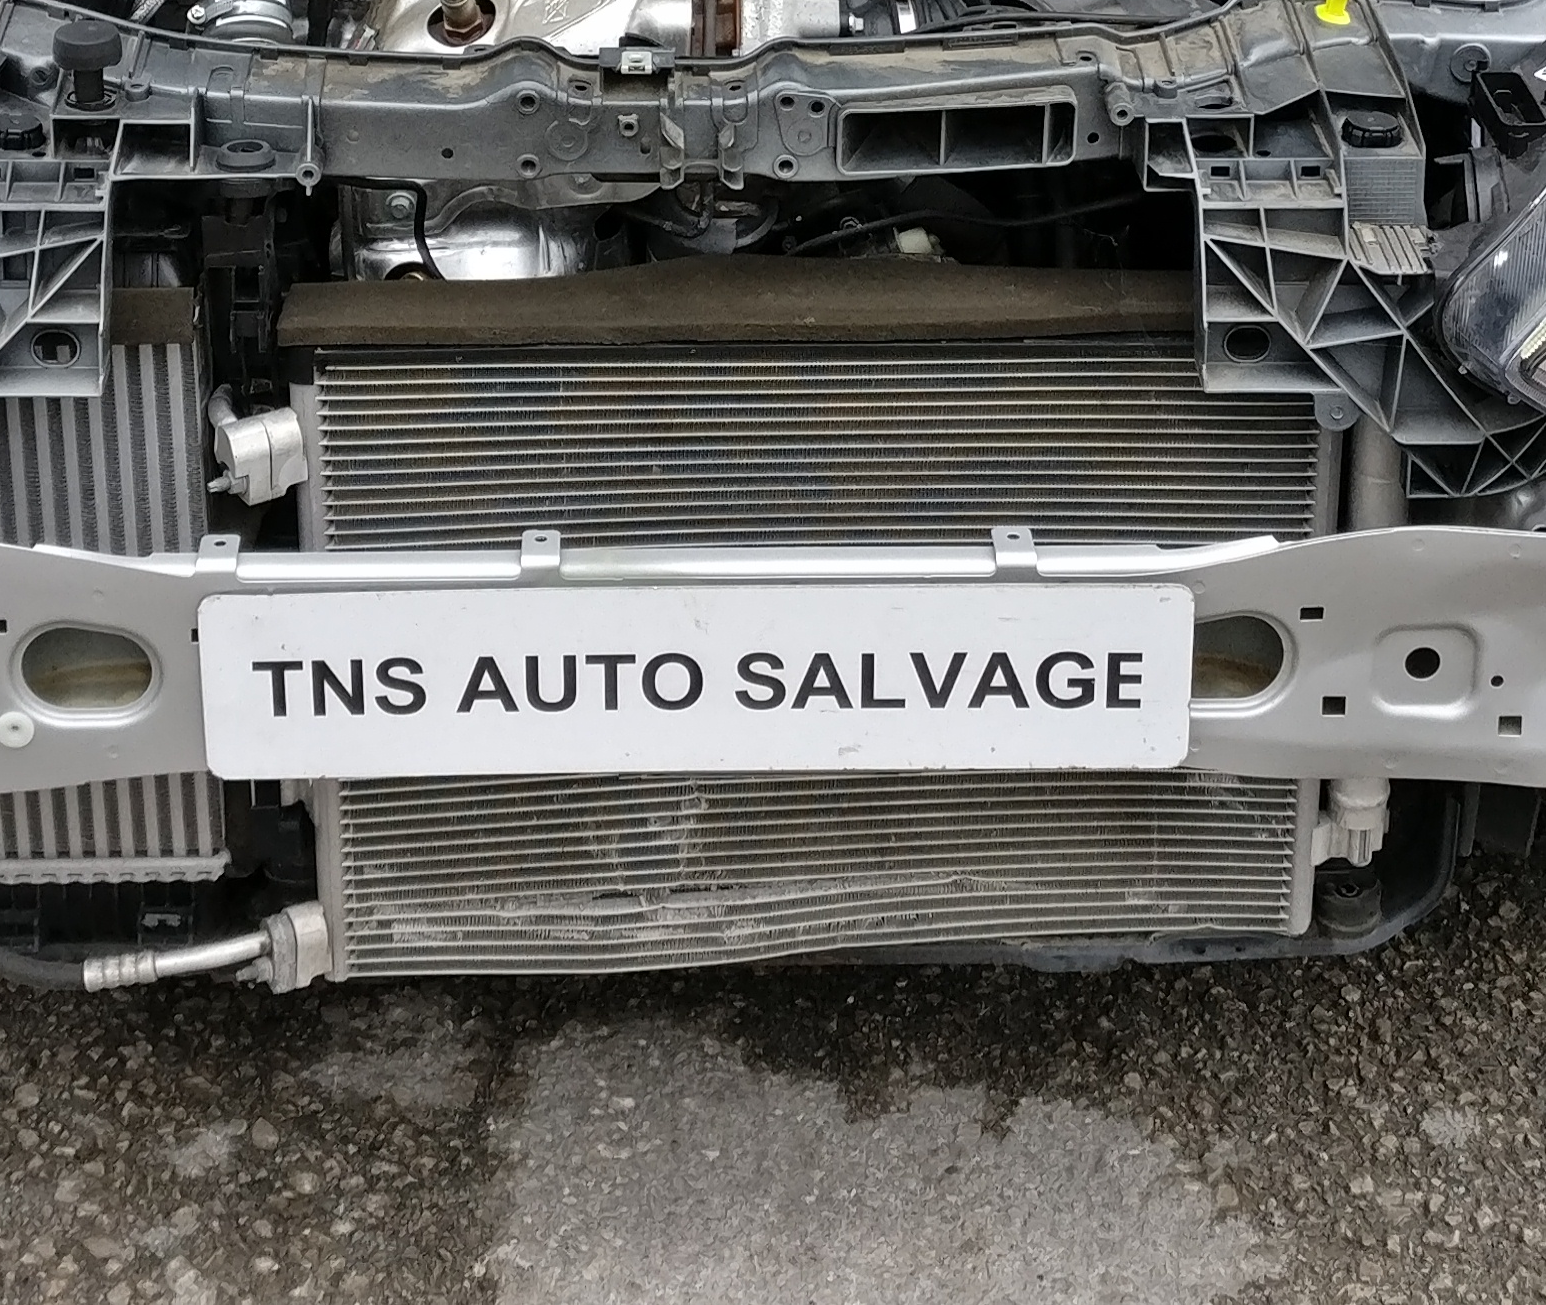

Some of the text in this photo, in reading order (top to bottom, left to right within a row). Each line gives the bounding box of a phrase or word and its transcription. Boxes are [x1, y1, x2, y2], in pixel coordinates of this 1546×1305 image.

[251, 650, 1144, 718] TNS AUTO SALVAGE
